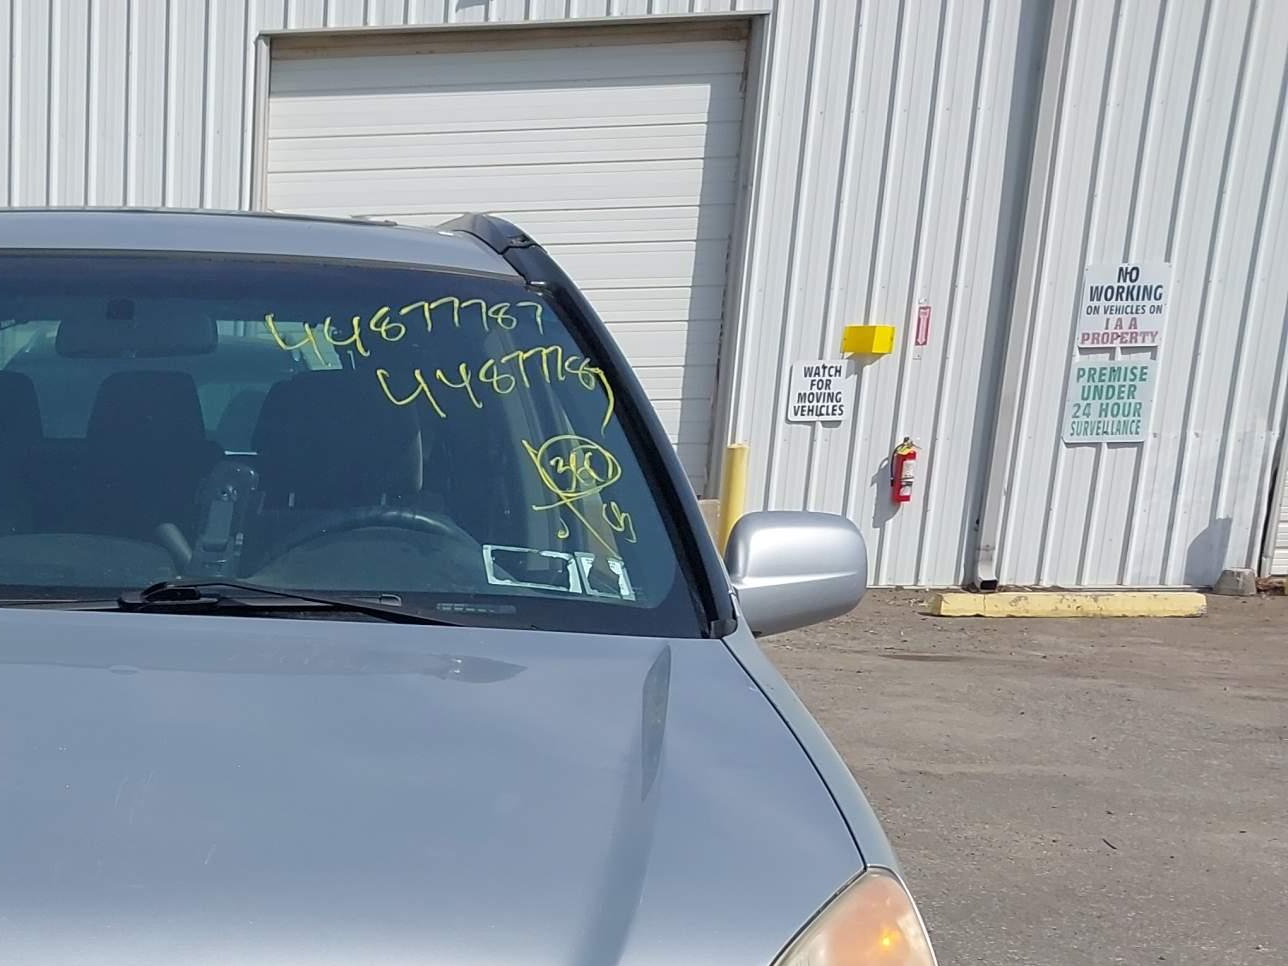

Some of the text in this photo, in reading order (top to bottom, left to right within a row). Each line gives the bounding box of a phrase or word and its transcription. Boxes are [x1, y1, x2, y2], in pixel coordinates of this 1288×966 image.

[1117, 266, 1140, 283] NO
[1089, 285, 1163, 302] WORKING
[1086, 304, 1163, 315] ON VEHICLES ON
[265, 297, 543, 367] 44877787
[1080, 331, 1158, 345] PROPERTY
[803, 365, 842, 378] WATCH
[1076, 366, 1149, 383] PREMISE
[810, 379, 832, 391] FOR
[1081, 384, 1137, 401] UNDER
[797, 391, 842, 404] MOVING
[793, 404, 845, 417] VEHICLES
[1072, 402, 1142, 419] 24 HOUR
[1070, 420, 1141, 436] SURVEILLANCE
